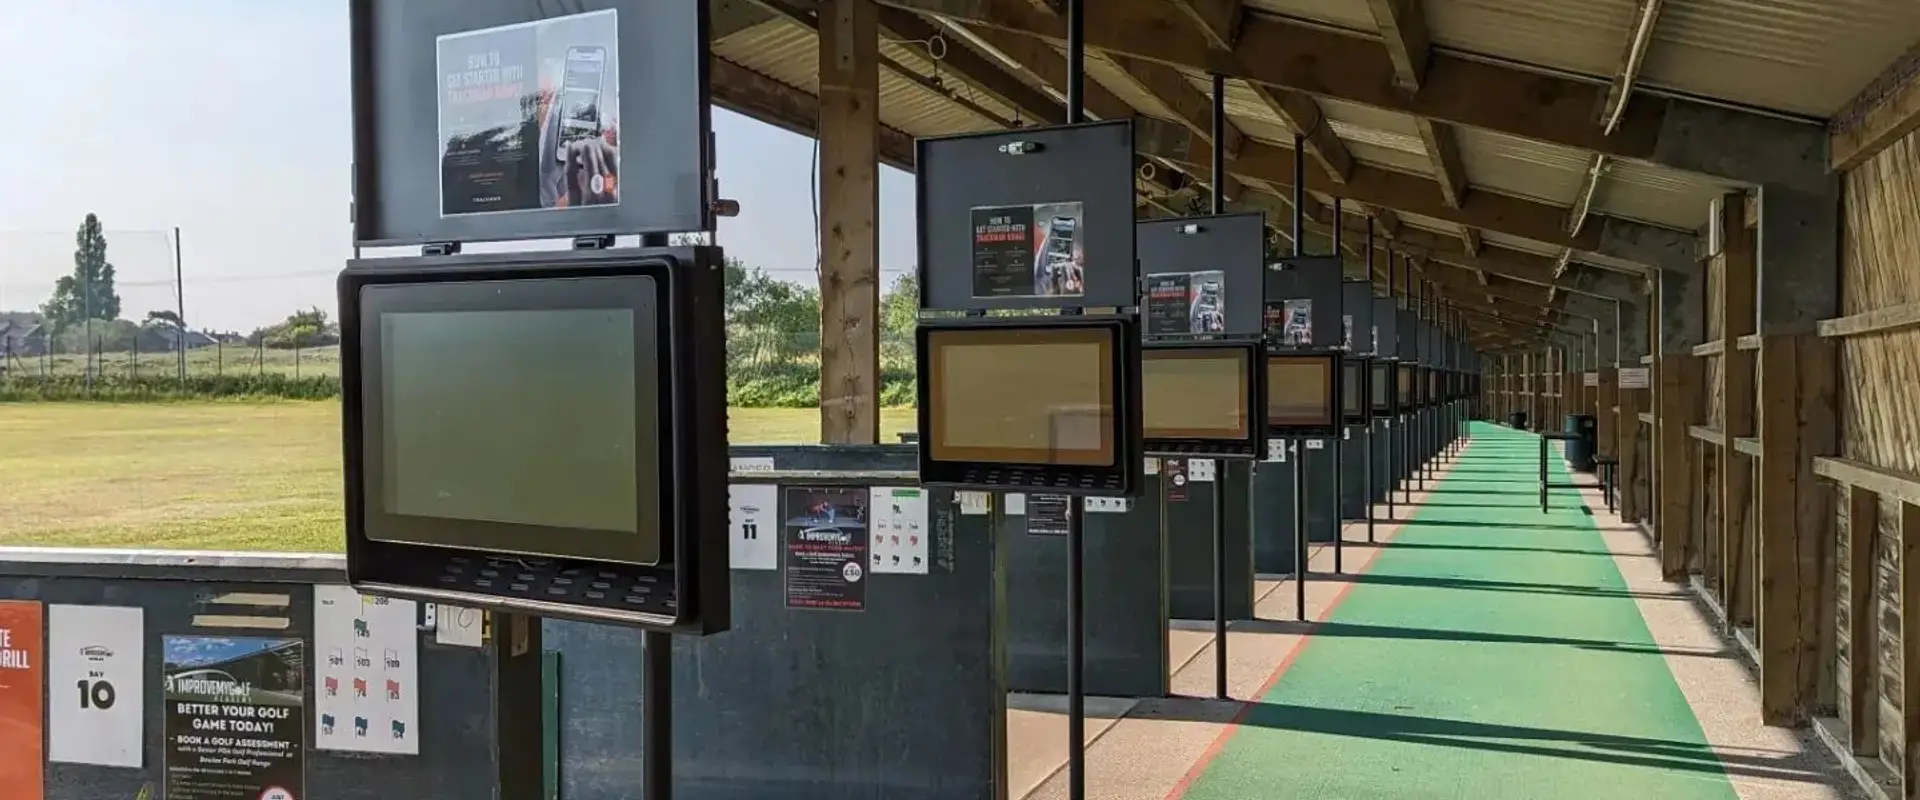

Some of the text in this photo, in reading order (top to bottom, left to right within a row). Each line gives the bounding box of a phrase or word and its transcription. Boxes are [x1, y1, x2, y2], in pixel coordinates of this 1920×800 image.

[742, 524, 757, 540] 11
[77, 679, 116, 710] 10
[177, 702, 290, 719] BETTER YOUR GOLF
[192, 718, 274, 733] GAME TODAY!
[177, 735, 290, 749] BOOK A GOLF ASSESSMENT
